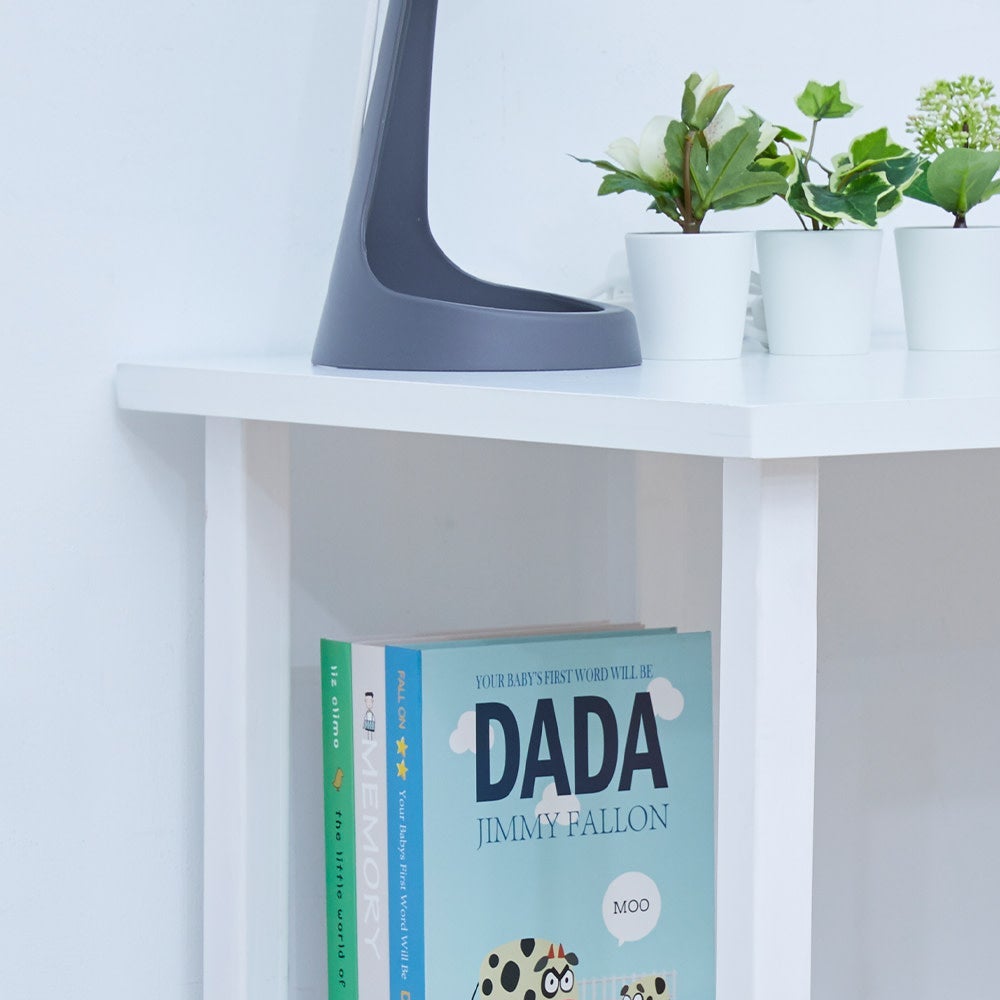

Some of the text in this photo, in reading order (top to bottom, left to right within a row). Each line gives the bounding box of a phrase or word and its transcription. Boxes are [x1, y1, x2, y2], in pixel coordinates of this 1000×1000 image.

[475, 664, 653, 690] YOUR BABY'S FIRST WORD WILL BE
[330, 665, 340, 749] liz climo
[475, 691, 669, 802] DADA
[398, 789, 407, 821] Your
[335, 810, 343, 842] the
[476, 803, 669, 850] JIMMY FALLON
[362, 739, 381, 961] MEMORY
[399, 863, 408, 890] First
[400, 894, 409, 932] Word
[612, 897, 650, 915] MOO
[337, 909, 345, 959] world
[400, 935, 409, 961] Will
[338, 968, 346, 989] of
[400, 965, 408, 980] Be
